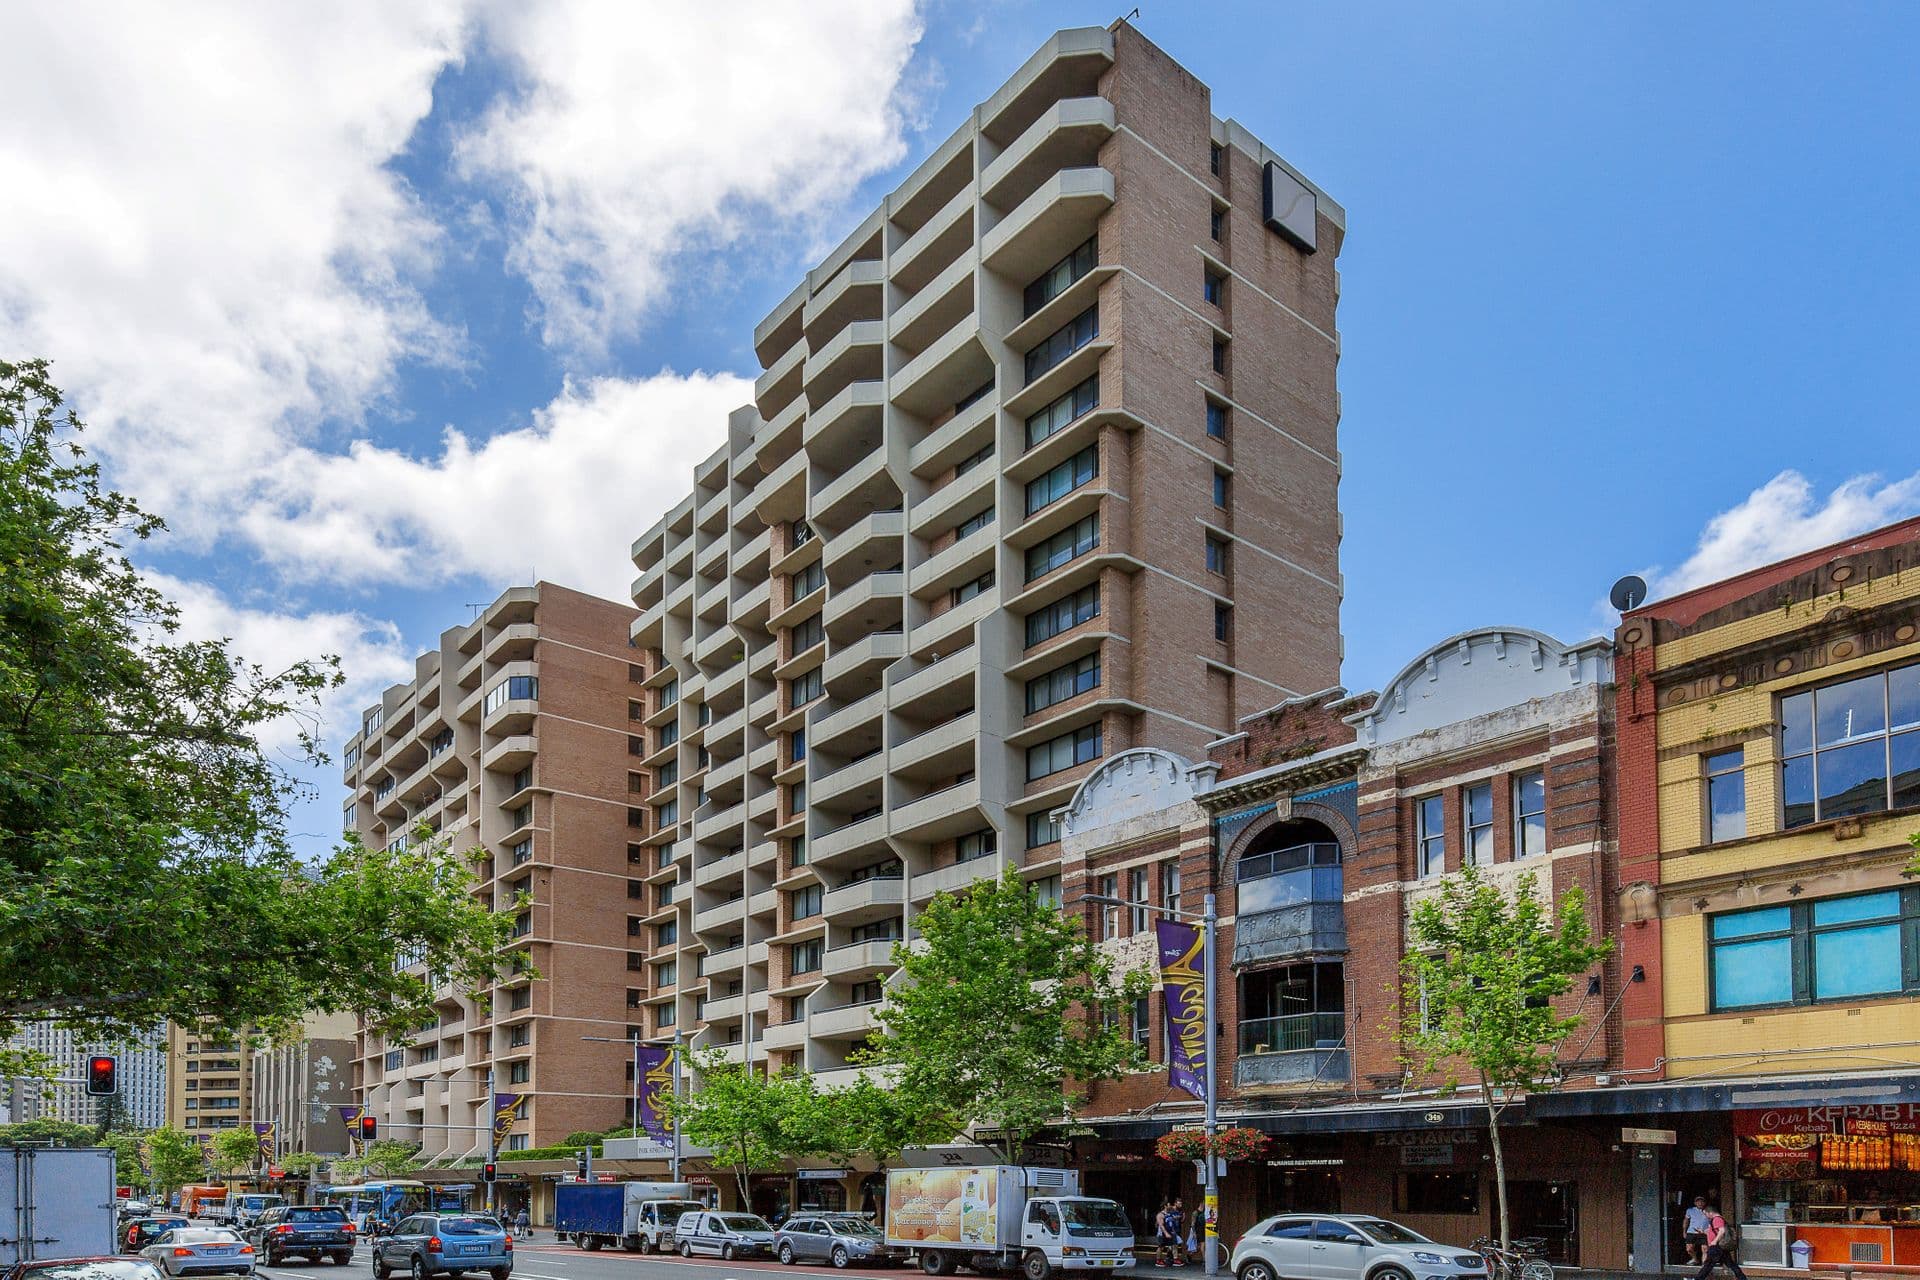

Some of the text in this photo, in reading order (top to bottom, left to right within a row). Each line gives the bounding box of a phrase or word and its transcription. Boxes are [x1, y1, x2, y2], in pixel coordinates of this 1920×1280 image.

[1760, 1111, 1803, 1131] Our
[1808, 1104, 1901, 1123] KEBAB
[1794, 1123, 1828, 1132] Kebab
